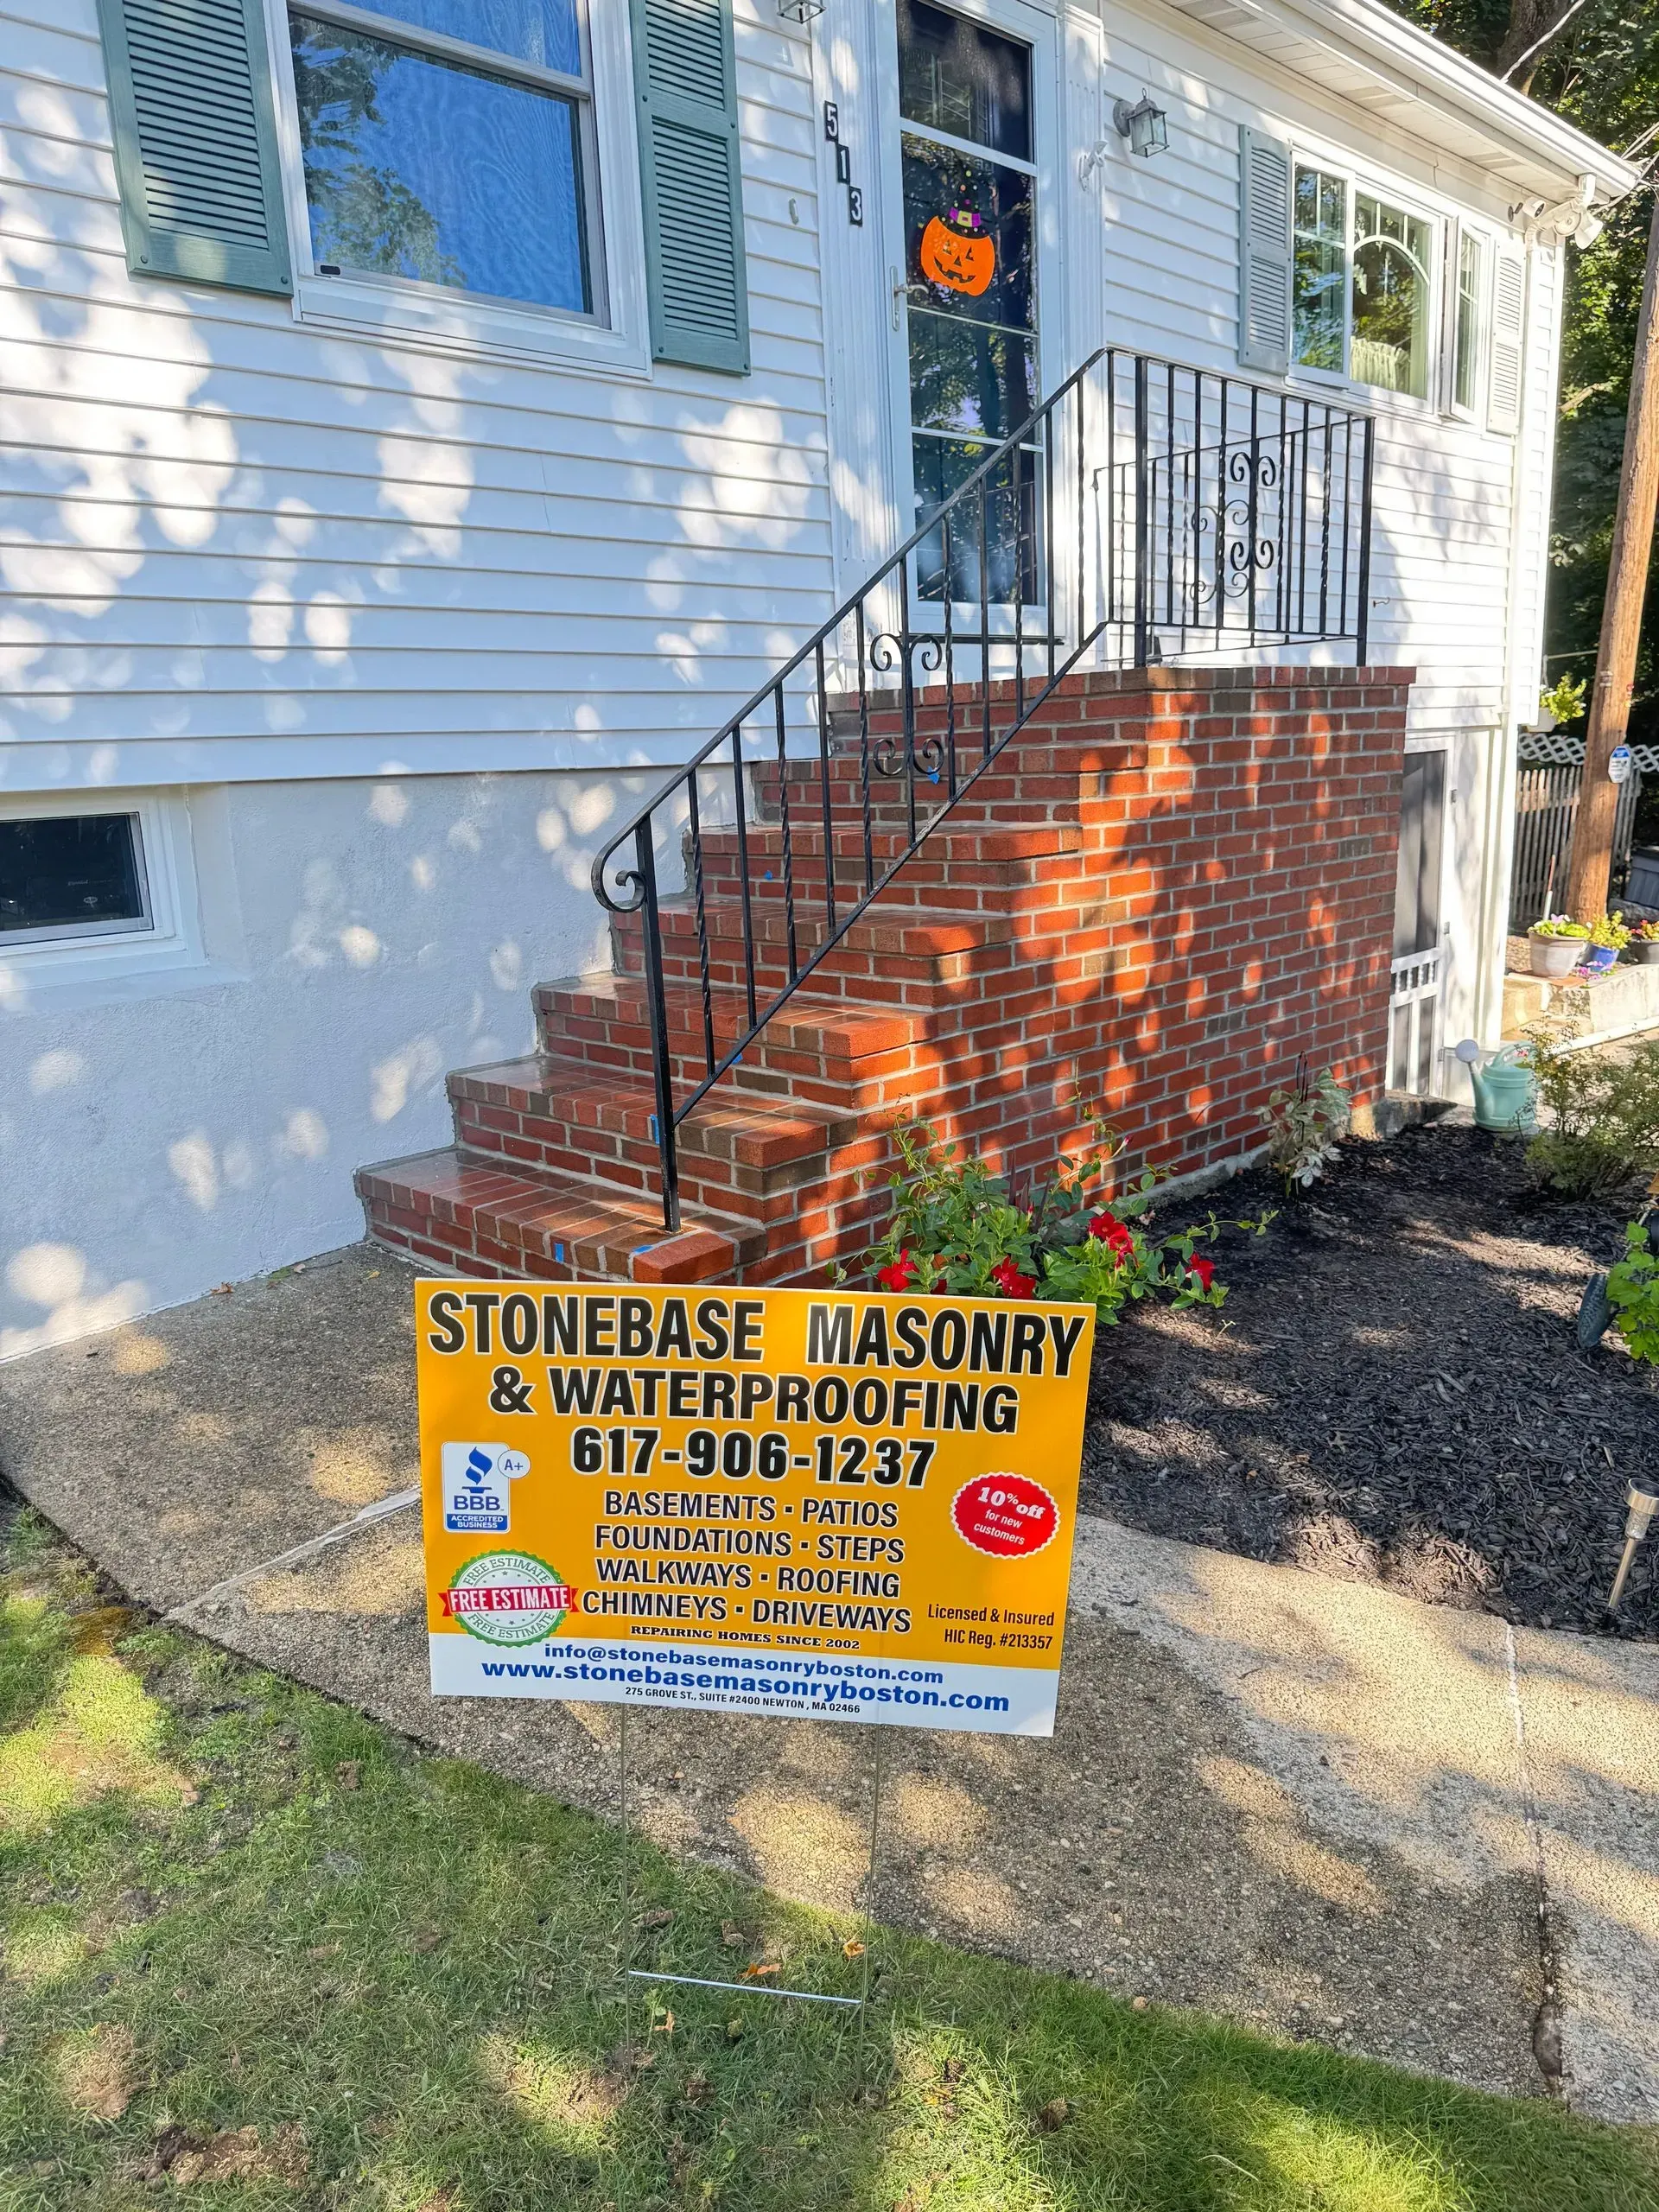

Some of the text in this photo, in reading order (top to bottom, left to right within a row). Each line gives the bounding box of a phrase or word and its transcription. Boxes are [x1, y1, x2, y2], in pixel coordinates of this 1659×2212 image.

[429, 1292, 1087, 1377] STONEBASE MASONRY
[489, 1365, 1019, 1434] & WATERPROOFING
[504, 1459, 524, 1471] A+
[571, 1426, 937, 1489] 617-906-1237
[454, 1495, 500, 1510] BBB
[605, 1491, 898, 1528] BASEMENTS PATIOS
[985, 1510, 1023, 1529] for new
[594, 1524, 905, 1563] FOUNDATIONS STEPS
[974, 1523, 1025, 1545] customers
[463, 1557, 550, 1586] FREE ESTIMATE
[595, 1558, 900, 1599] WALKWAYS ROOFING
[449, 1587, 570, 1611] FREE ESTIMATE
[582, 1591, 912, 1633] CHIMNEYS DRIVEWAYS
[467, 1612, 555, 1639] FREE ESTIMATE
[928, 1604, 1054, 1626] Licensed & Insured
[631, 1625, 860, 1649] REPAIRING HOMES SINCE 2002
[944, 1629, 1053, 1649] HIC Reg. #213357
[544, 1643, 944, 1684] info@stonebasemasonryboston.com
[481, 1662, 1009, 1712] www.stonebasemasonryboston.com
[625, 1687, 643, 1696] 275
[645, 1688, 678, 1699] GROVE
[680, 1690, 697, 1702] ST.,
[699, 1693, 728, 1703] SUITE
[728, 1694, 760, 1706] #2400
[762, 1698, 804, 1709] NEWTON
[812, 1701, 827, 1711] MA
[830, 1703, 861, 1713] 02466
